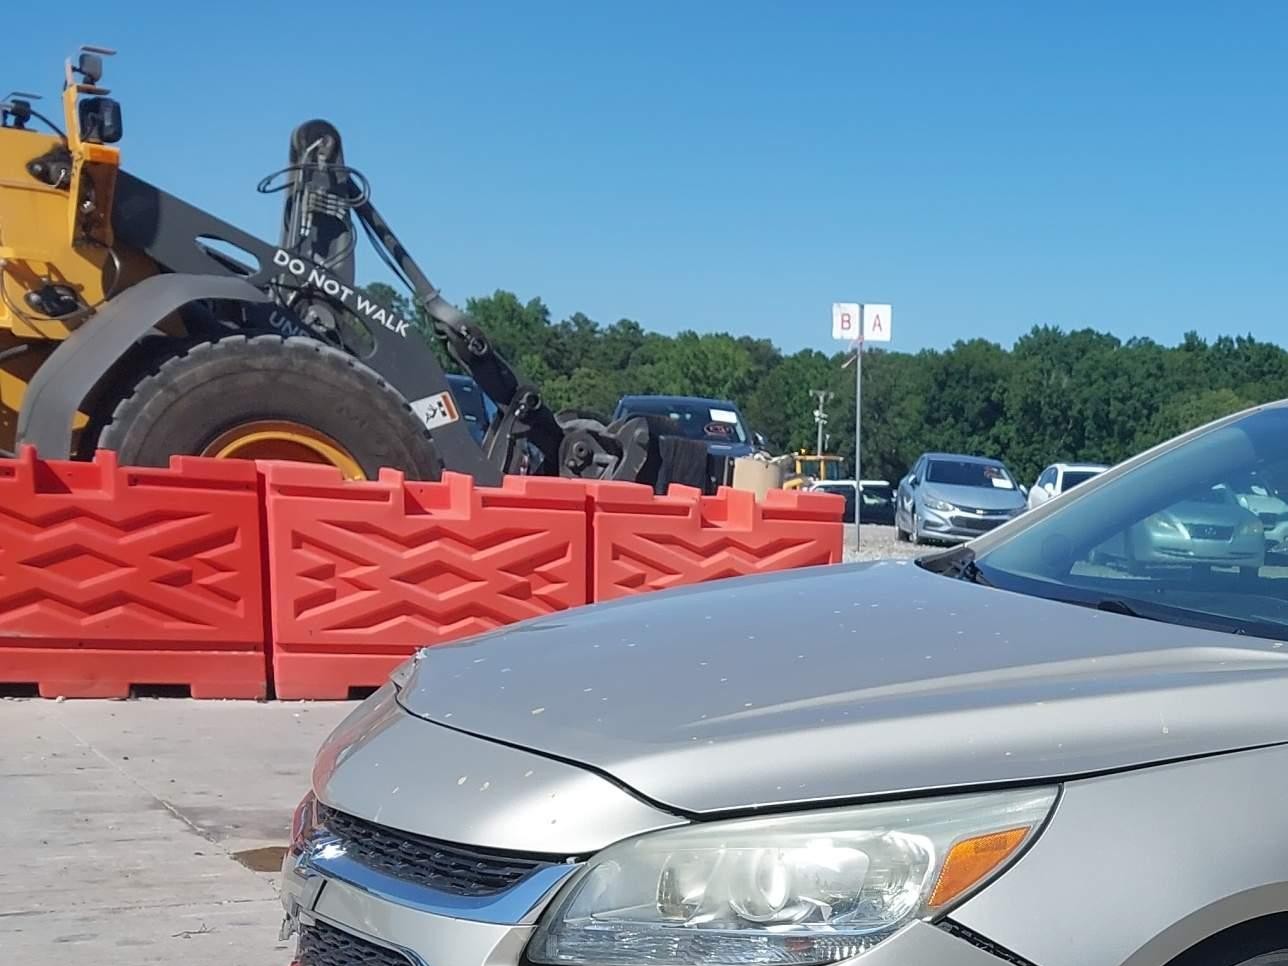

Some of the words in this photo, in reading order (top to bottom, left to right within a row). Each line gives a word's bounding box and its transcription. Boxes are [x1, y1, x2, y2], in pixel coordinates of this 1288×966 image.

[273, 249, 305, 274] DO
[308, 268, 354, 303] NOT
[356, 295, 411, 338] WALK
[841, 313, 851, 330] B
[873, 314, 883, 332] A
